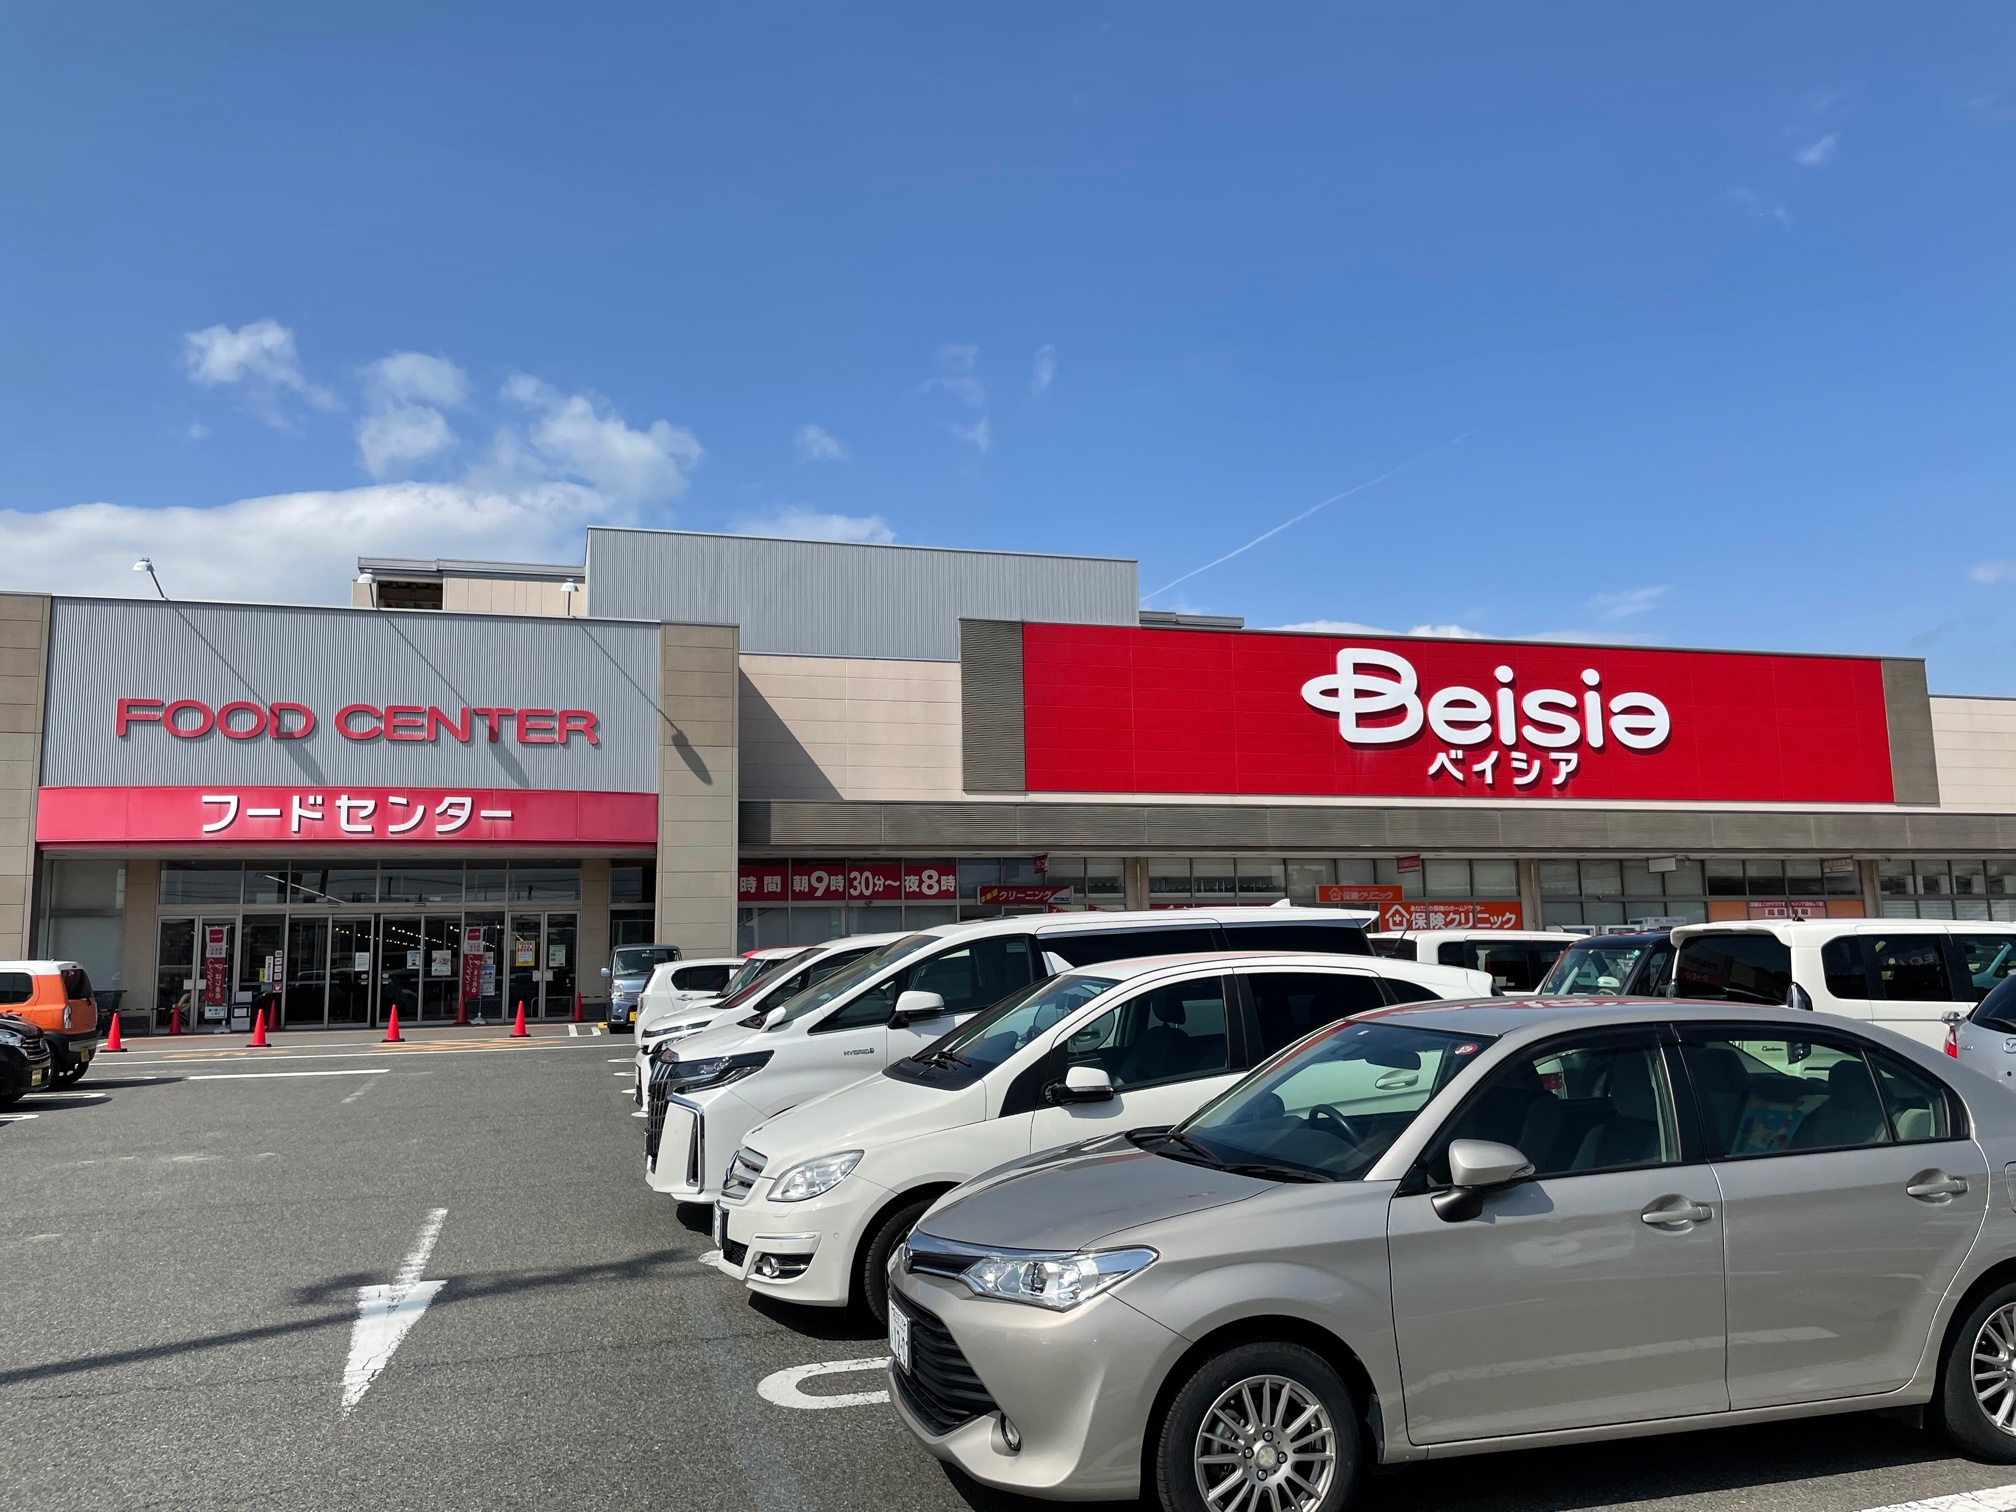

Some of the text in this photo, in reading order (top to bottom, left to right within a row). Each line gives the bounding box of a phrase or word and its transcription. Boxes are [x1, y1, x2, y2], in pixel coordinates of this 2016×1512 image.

[1301, 647, 1670, 749] Beisia
[116, 697, 601, 746] FOOD CENTER
[1428, 749, 1579, 786] ベイシア
[201, 794, 515, 834] フードセンター
[998, 890, 1053, 901] クリーニング
[1343, 891, 1394, 901] 保険クリニック
[1411, 911, 1517, 930] 保険クリニック
